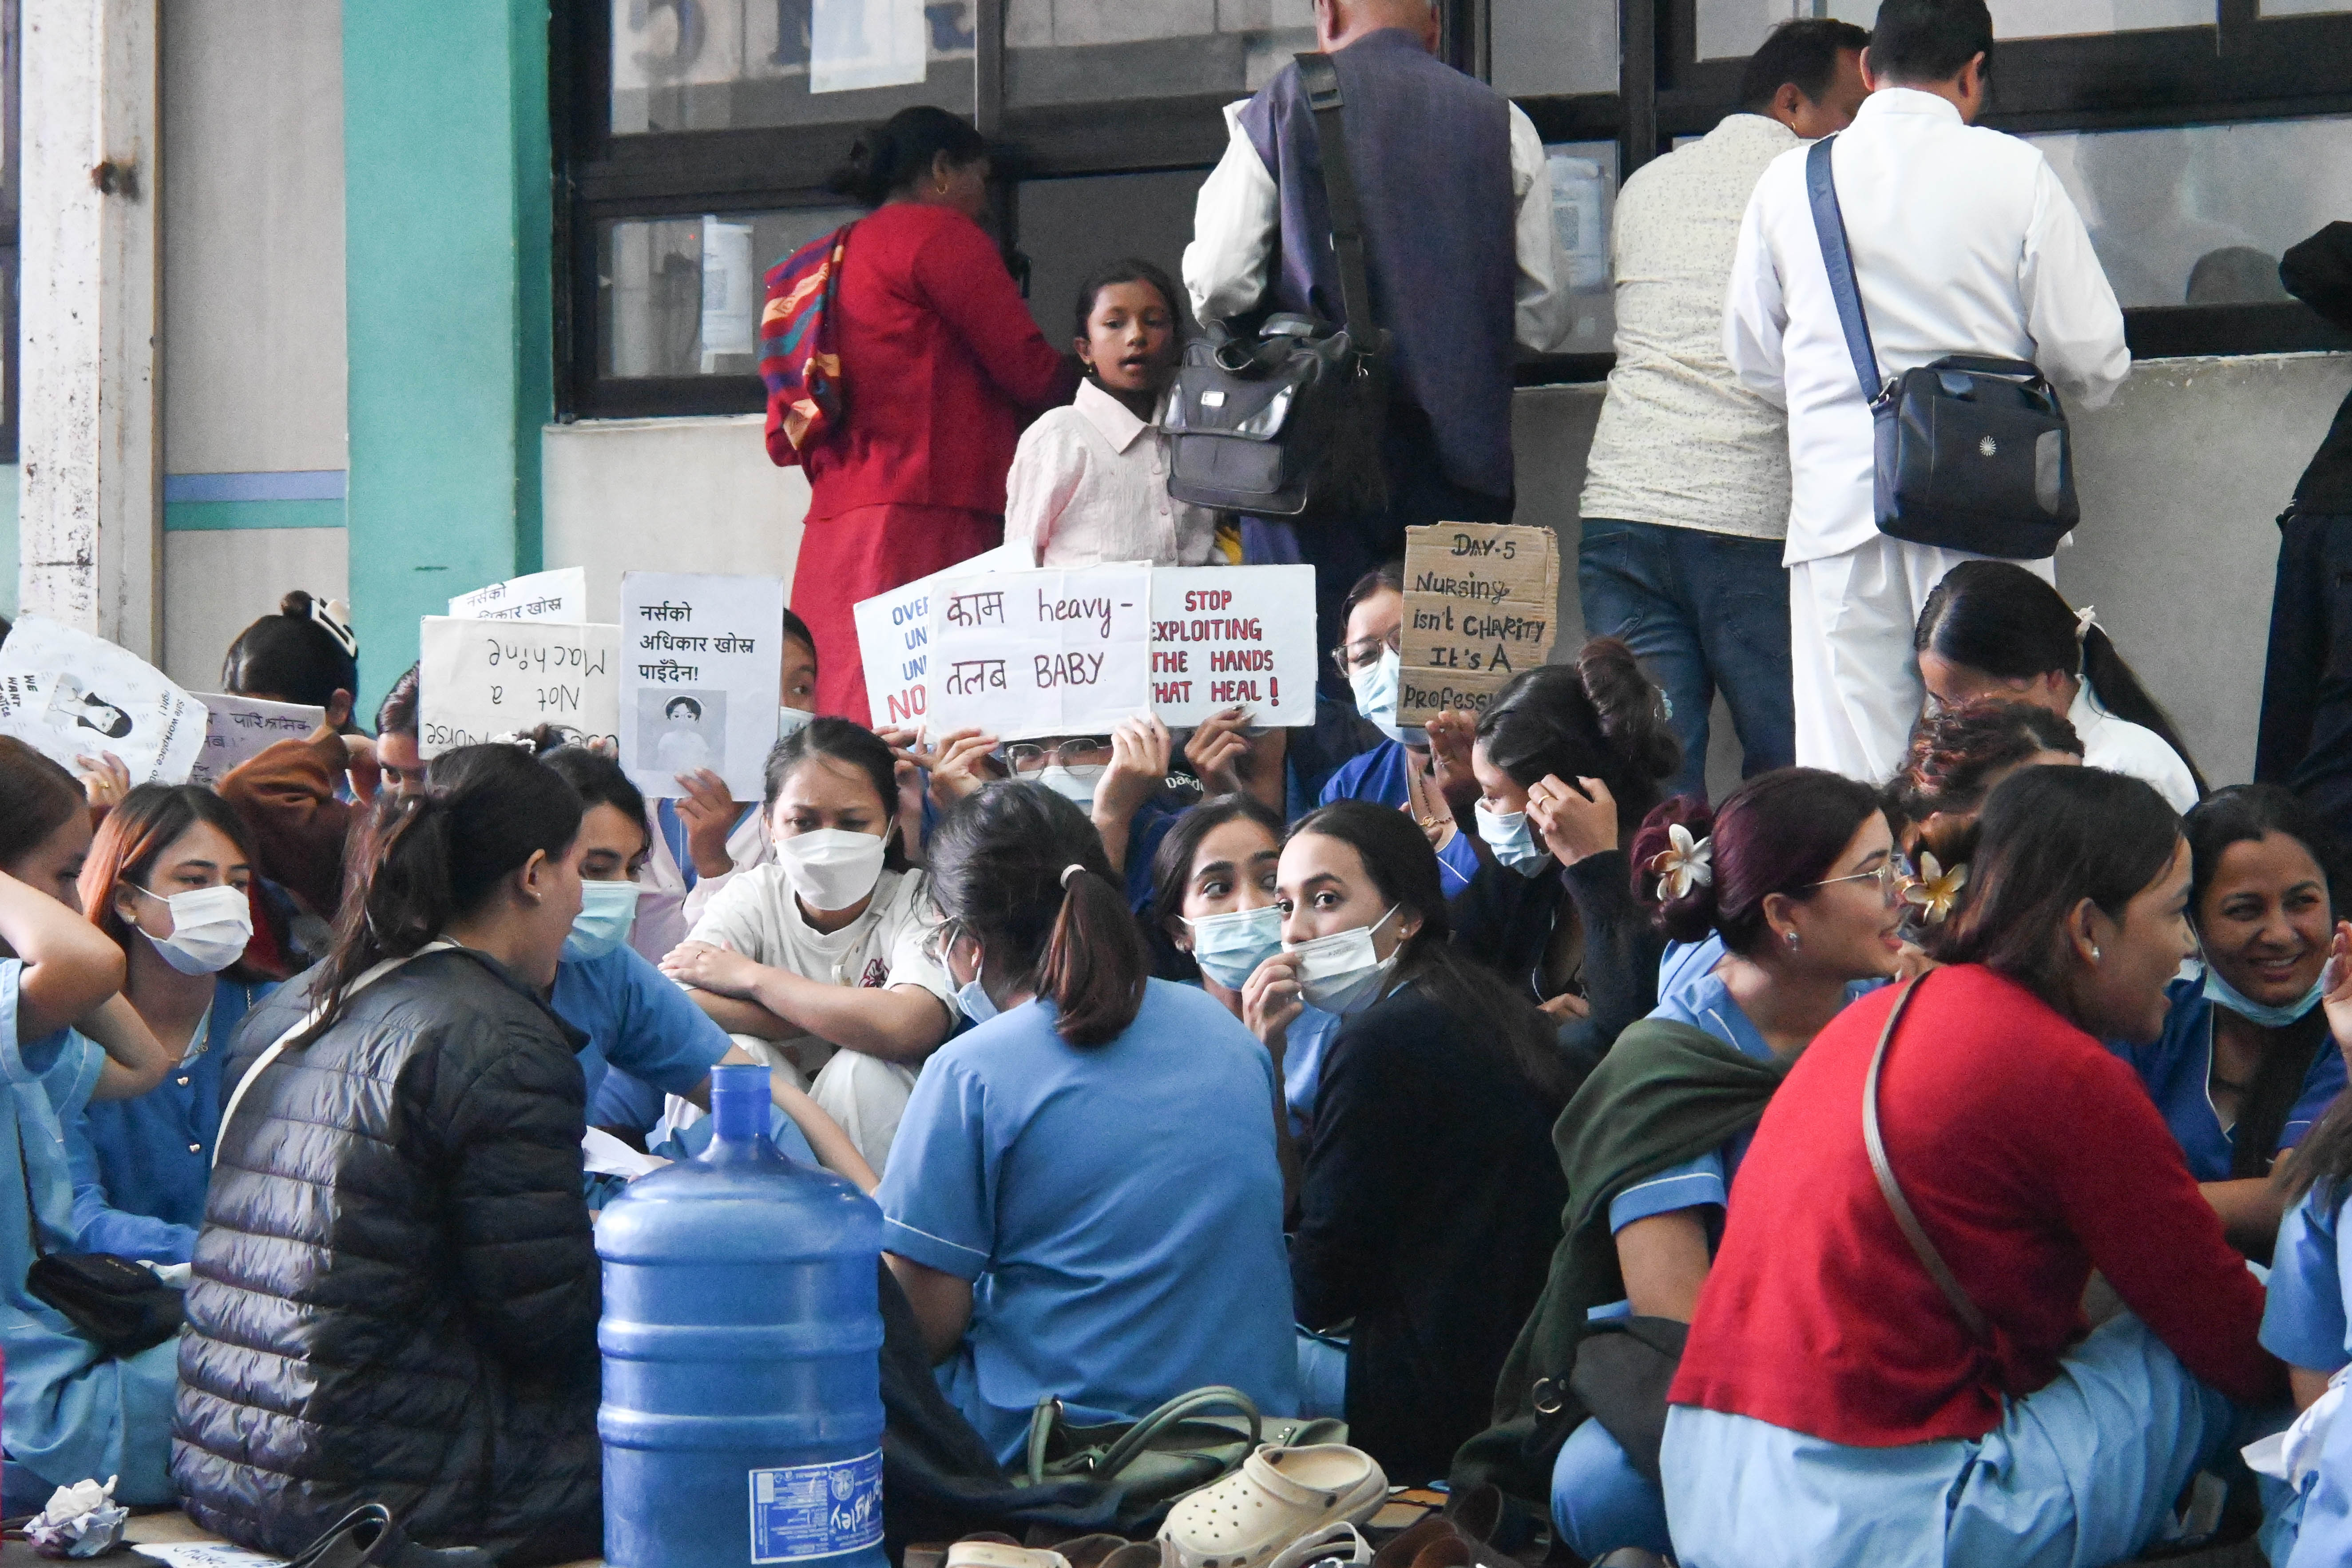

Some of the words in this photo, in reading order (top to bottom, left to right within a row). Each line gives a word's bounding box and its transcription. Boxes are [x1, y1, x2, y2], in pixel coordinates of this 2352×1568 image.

[639, 601, 692, 622] नर्सको
[947, 591, 1004, 627] काम
[1185, 590, 1232, 611] STOP
[1413, 605, 1454, 631] isn't
[640, 631, 708, 652] अधिकार
[714, 632, 755, 653] खोस्न
[905, 625, 928, 650] UN
[488, 639, 605, 677] Machine
[1152, 651, 1188, 673] THE
[1210, 650, 1274, 672] HANDS
[1430, 647, 1481, 670] It's
[1488, 643, 1512, 673] A
[639, 659, 698, 683] पाइँदैन!
[947, 659, 1007, 695] तलब
[1034, 652, 1104, 688] BABY
[8, 677, 21, 707] WANT
[24, 675, 39, 692] WE
[492, 685, 503, 705] a
[1153, 680, 1192, 703] HAT
[175, 699, 185, 717] Safe
[538, 687, 580, 712] Not
[149, 770, 158, 782] ou
